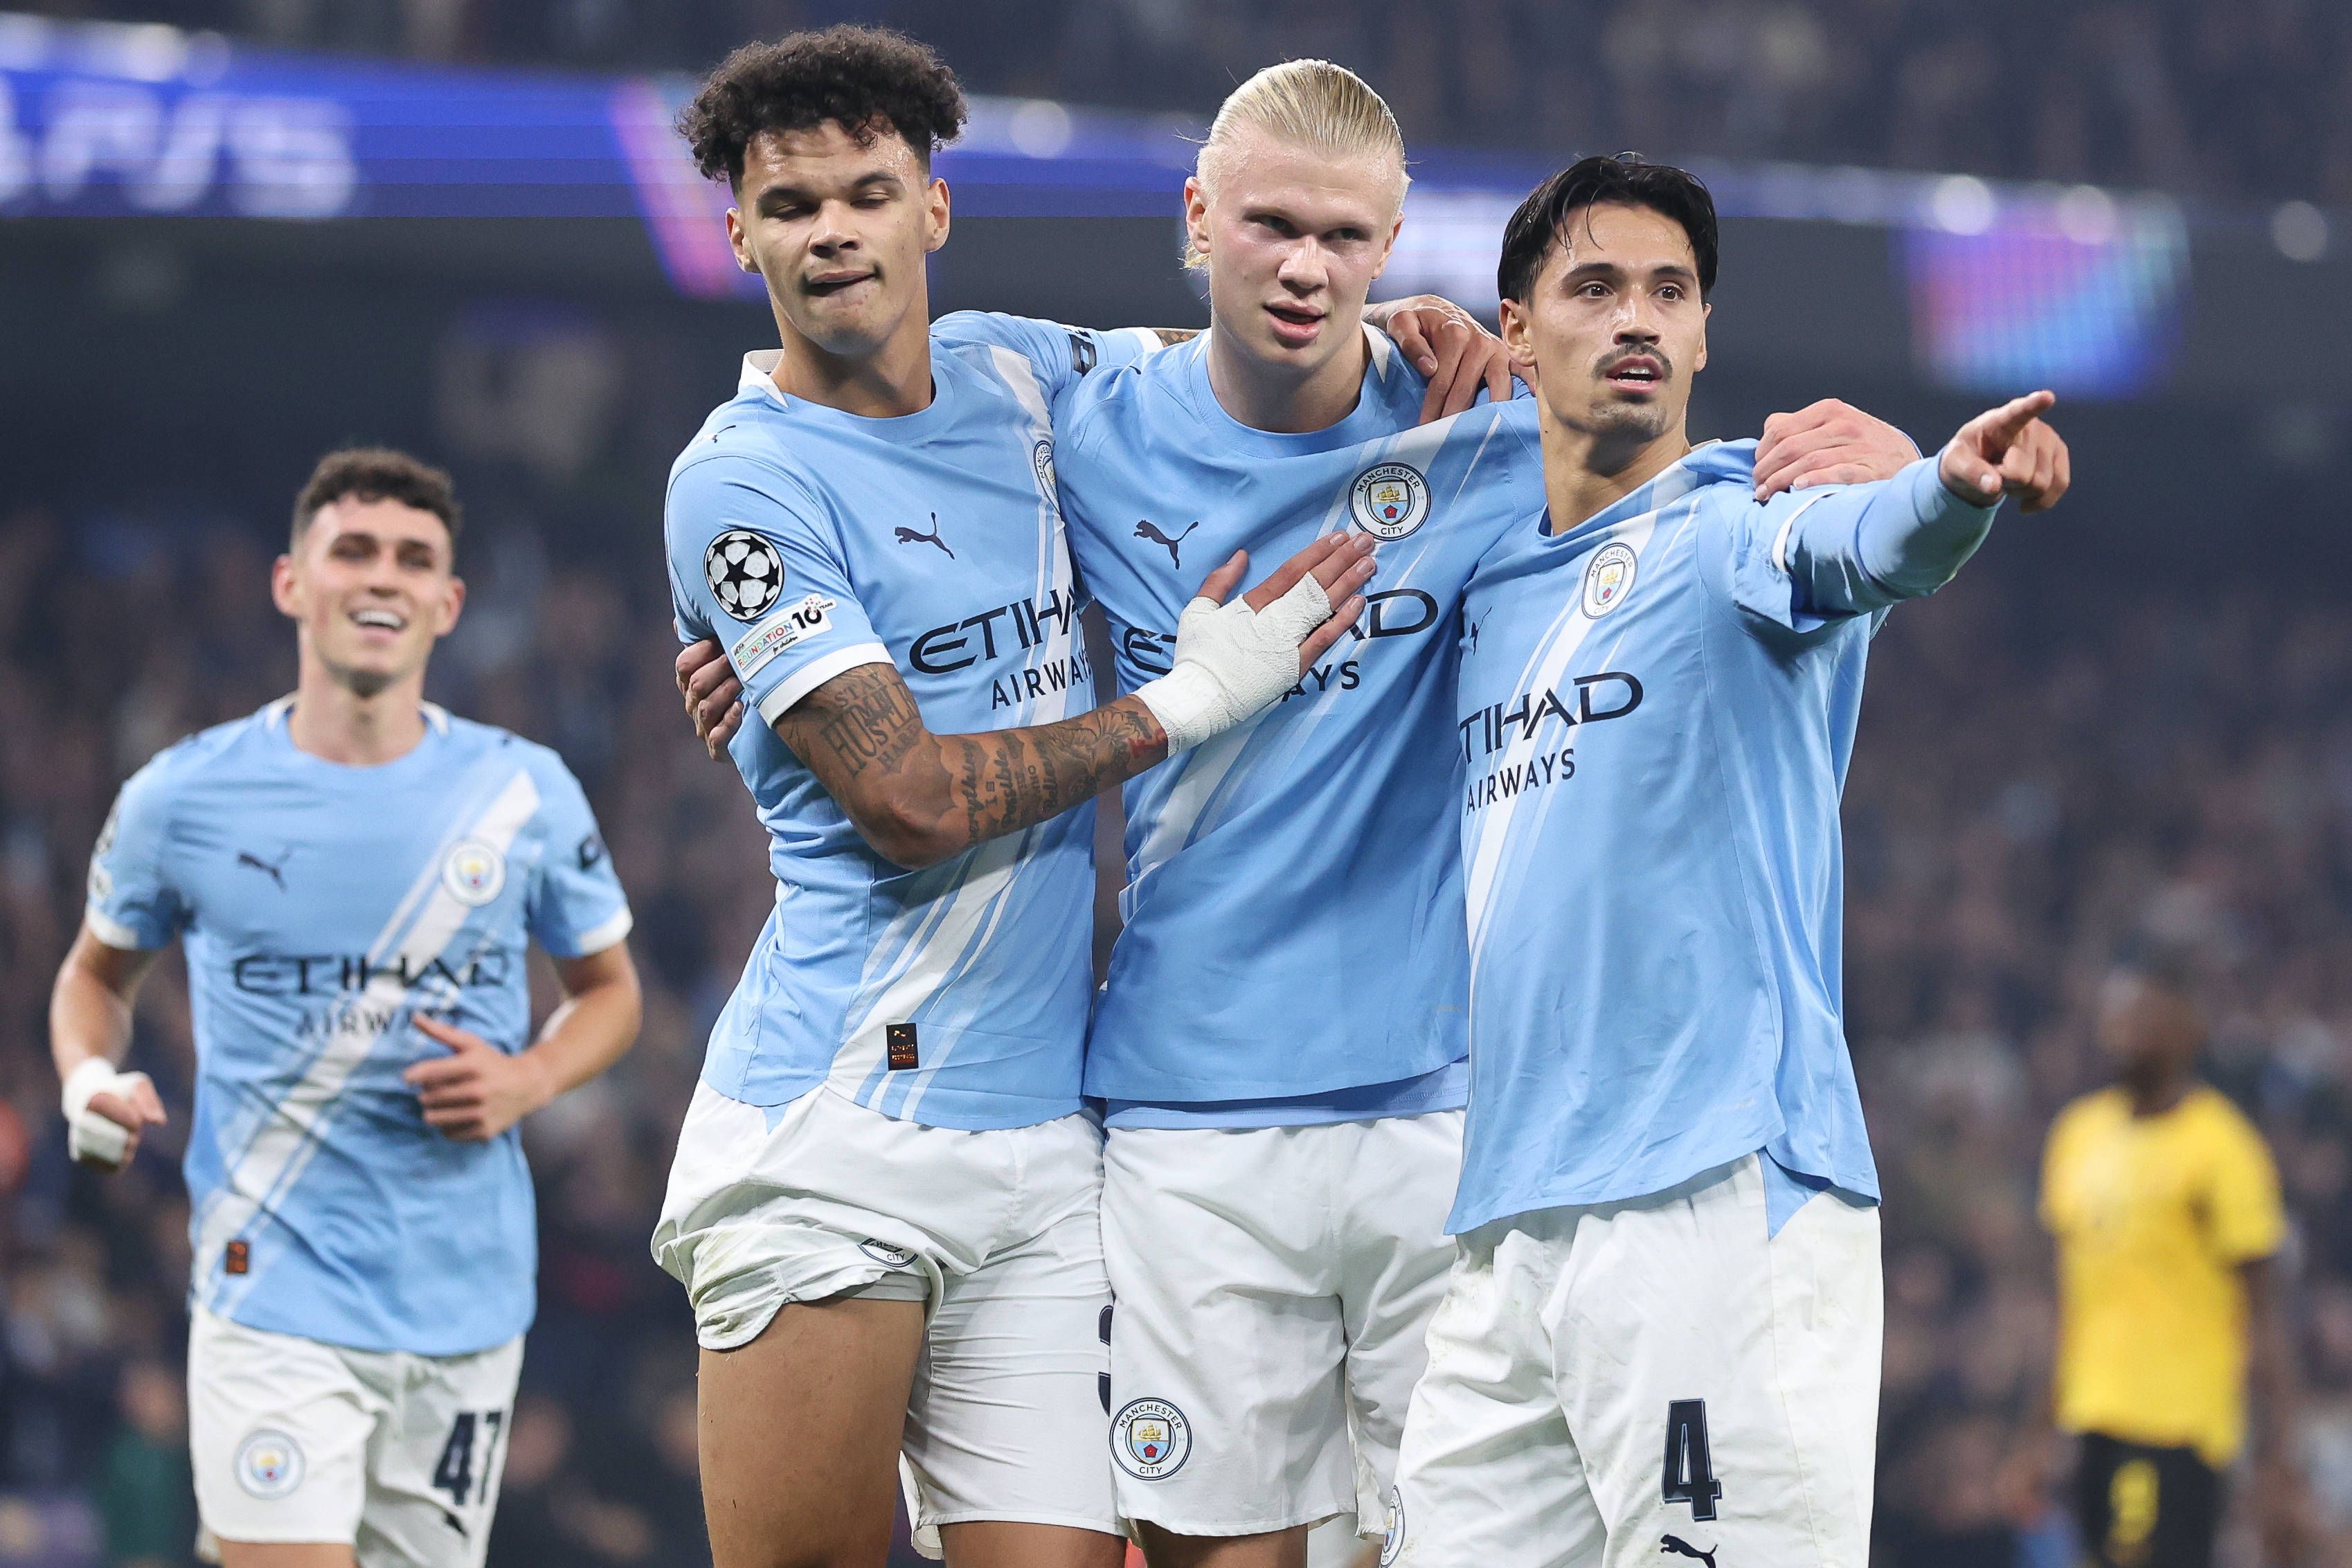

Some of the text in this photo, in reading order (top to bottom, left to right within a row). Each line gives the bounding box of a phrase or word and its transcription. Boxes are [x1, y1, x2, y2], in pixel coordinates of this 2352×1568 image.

[1357, 468, 1420, 492] MANCHESTER
[1381, 527, 1403, 535] CITY
[1591, 549, 1633, 577] MANCHESTER
[791, 607, 822, 629] 10
[1594, 606, 1608, 614] CITY
[737, 622, 793, 668] FOUNDATION
[992, 649, 1092, 710] AIRWAY
[1460, 672, 1644, 764] TIHAD
[1466, 748, 1575, 815] AIRWAYS
[1119, 1404, 1182, 1429] MANCHESTER
[1662, 1398, 1723, 1522] 4
